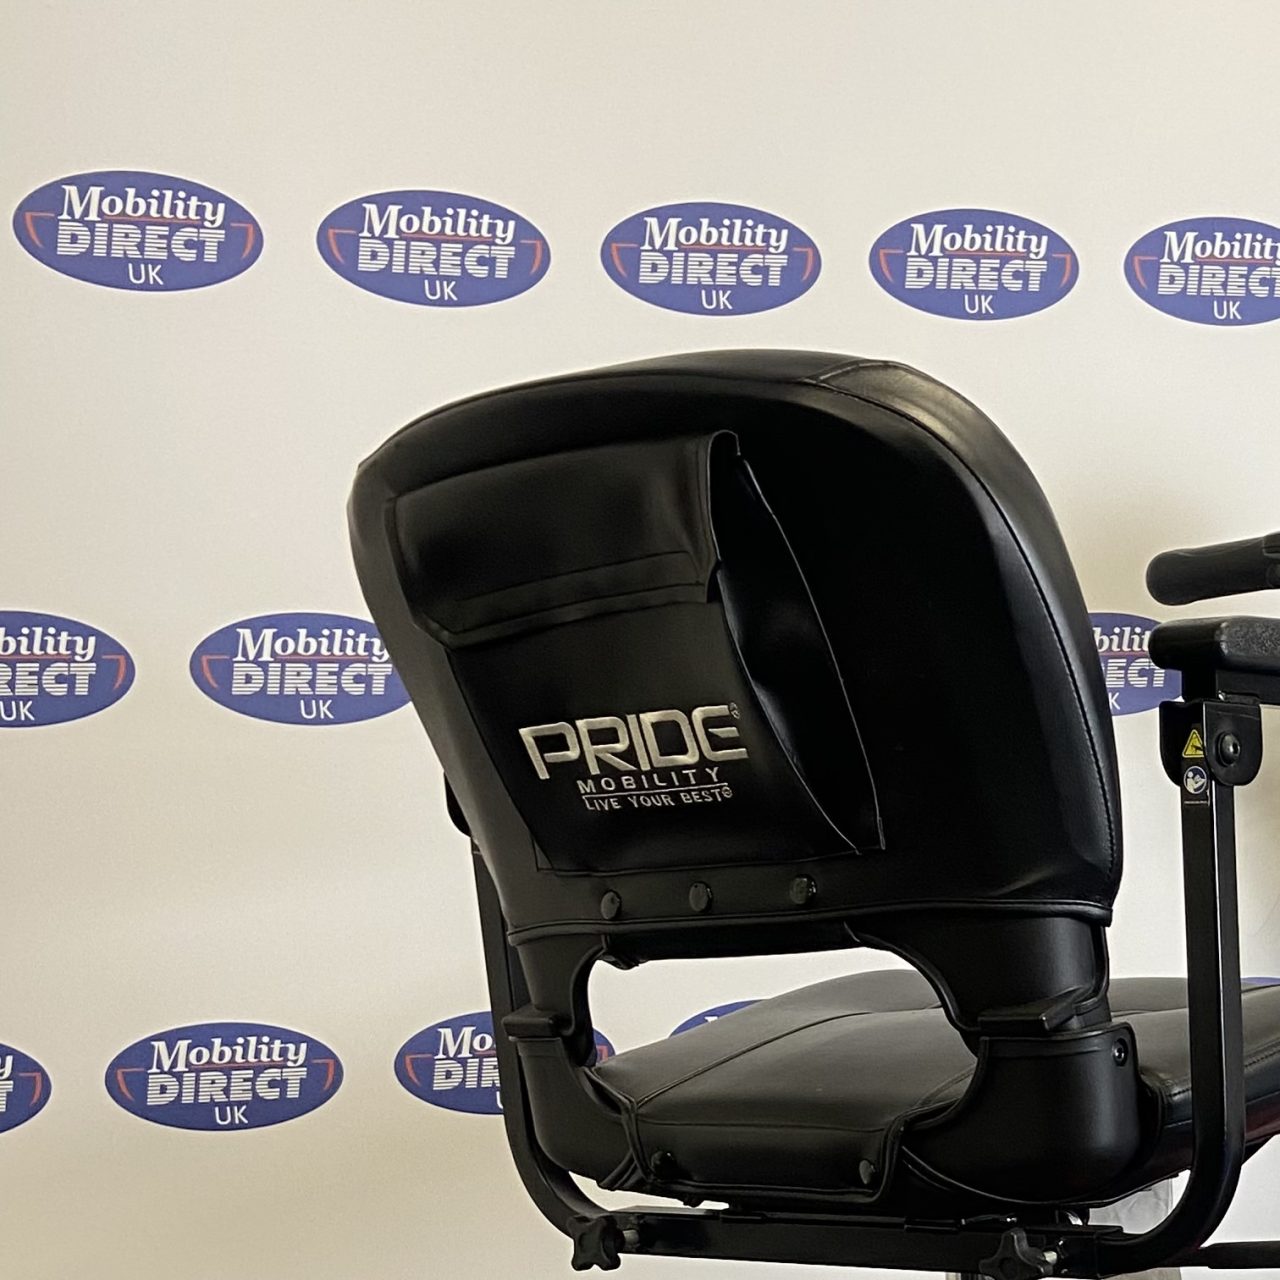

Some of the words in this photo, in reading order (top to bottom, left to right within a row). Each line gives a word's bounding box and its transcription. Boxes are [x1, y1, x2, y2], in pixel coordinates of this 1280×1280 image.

[57, 184, 225, 228] Mobility
[358, 203, 516, 245] Mobility
[640, 217, 789, 254] Mobility
[57, 221, 226, 262] DIRECT
[906, 223, 1049, 260] Mobility
[128, 263, 164, 285] UK
[357, 239, 516, 279] DIRECT
[638, 252, 789, 287] DIRECT
[904, 257, 1048, 292] DIRECT
[424, 279, 458, 301] UK
[701, 289, 733, 310] UK
[964, 294, 994, 314] UK
[1213, 300, 1242, 320] UK
[233, 628, 390, 663] Mobility
[231, 663, 393, 696] DIRECT
[0, 700, 35, 721] UK
[300, 699, 335, 720] UK
[576, 766, 720, 794] MOBILITY
[584, 796, 622, 811] LIVE
[627, 793, 676, 809] YOUR
[147, 1036, 308, 1073] Mobility
[146, 1068, 308, 1106] DIRECT
[214, 1105, 249, 1125] UK
